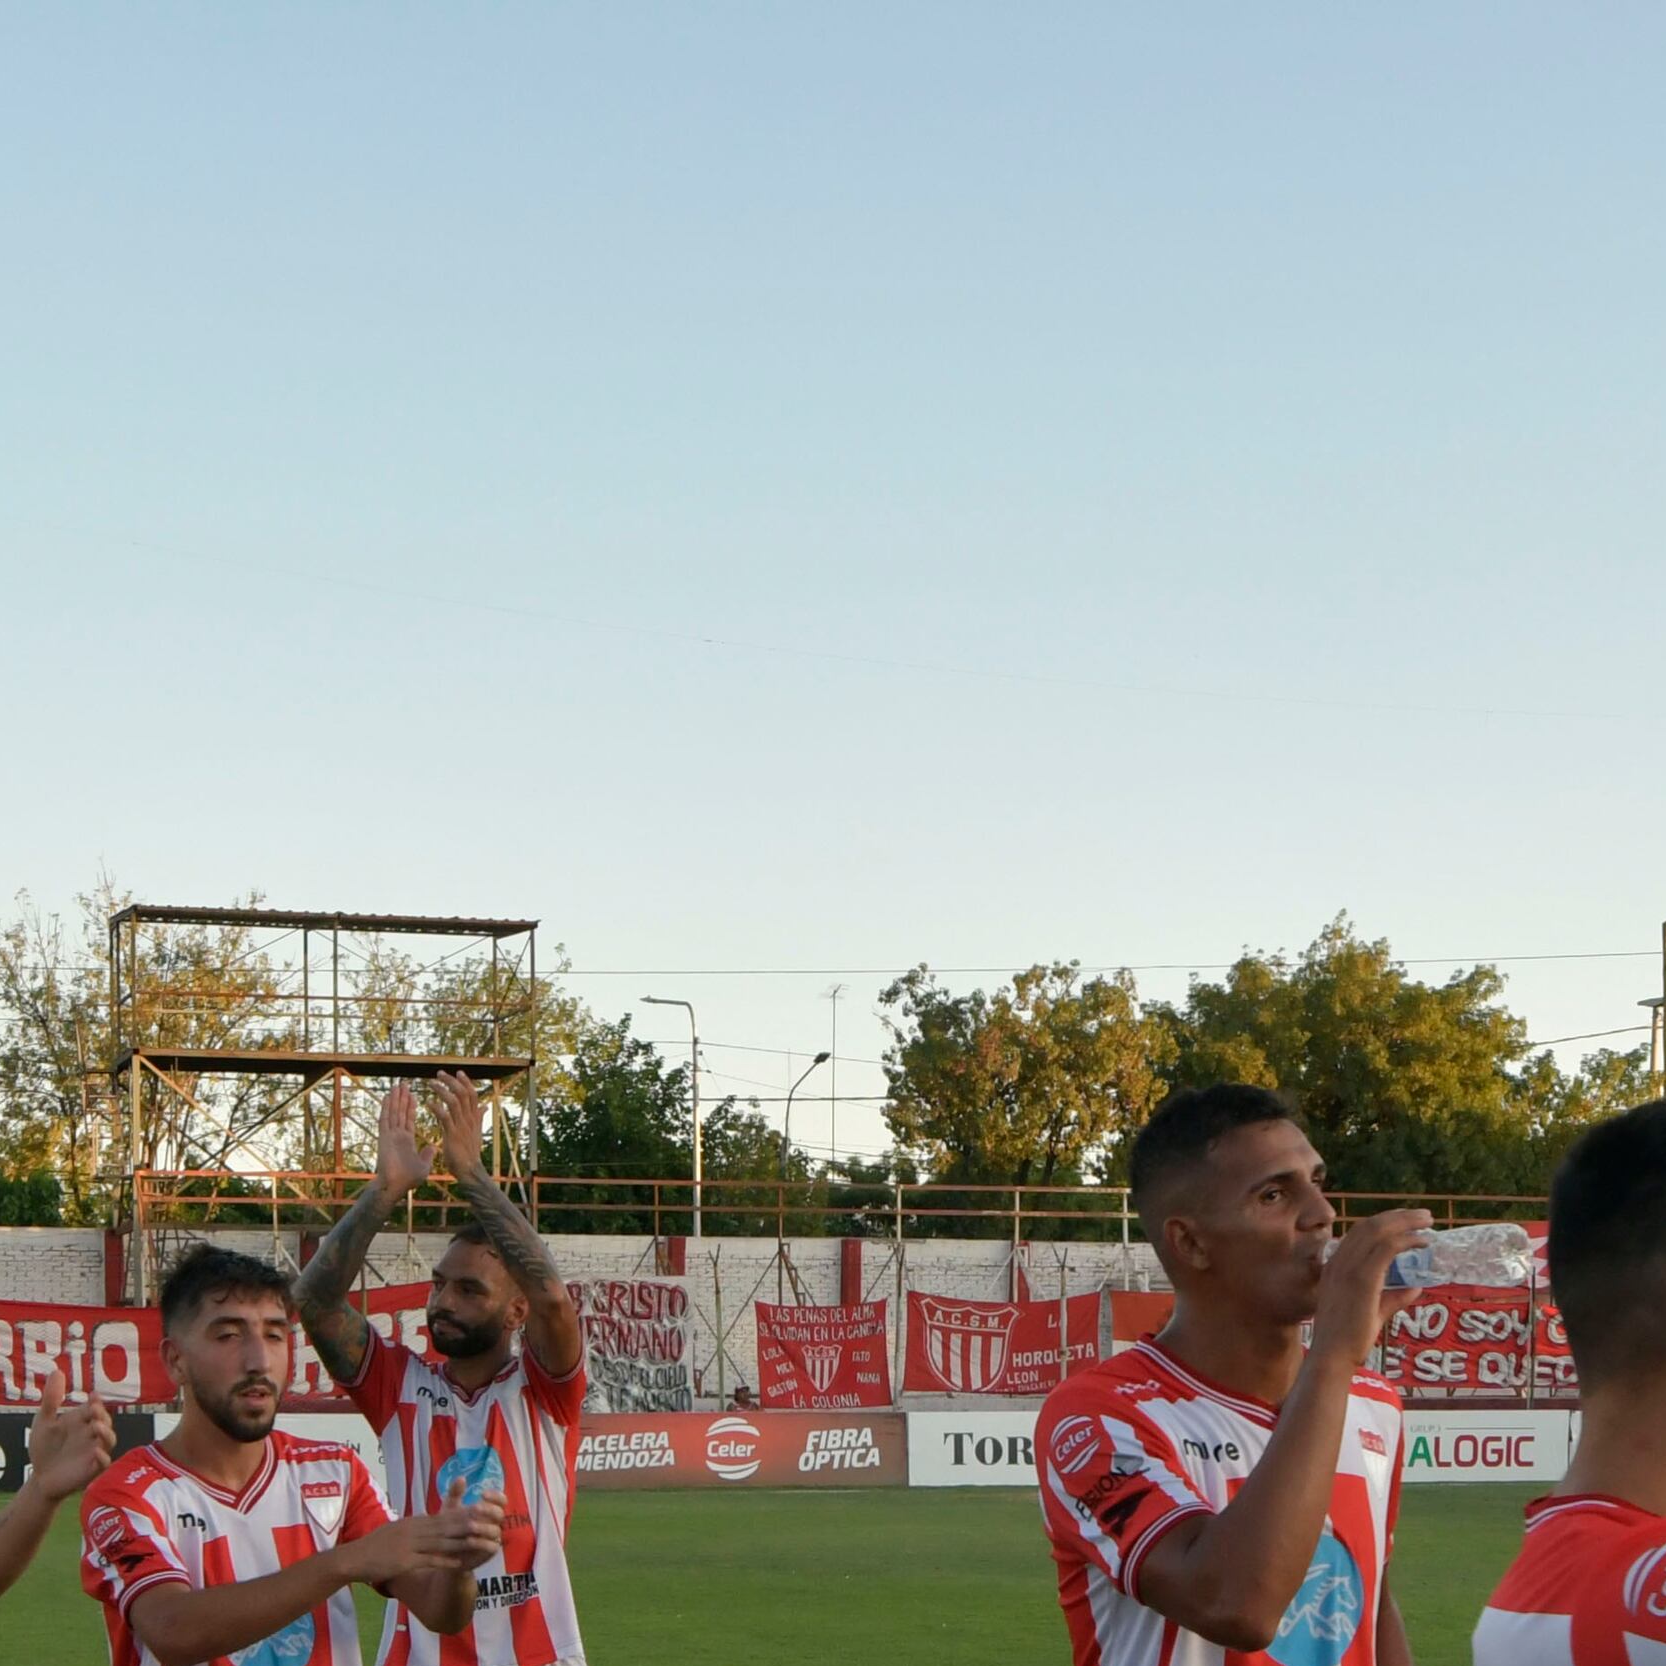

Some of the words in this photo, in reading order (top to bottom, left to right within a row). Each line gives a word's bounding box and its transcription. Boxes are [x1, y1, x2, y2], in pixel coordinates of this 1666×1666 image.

[593, 1279, 688, 1322] CRISTO
[770, 1307, 790, 1322] LAS
[830, 1308, 848, 1322] DEL
[1390, 1303, 1449, 1338] NO
[814, 1327, 828, 1341] EN
[832, 1327, 845, 1340] LA
[1413, 1350, 1468, 1381] SE
[1007, 1371, 1039, 1385] LEON
[792, 1393, 806, 1408] LA
[812, 1393, 861, 1408] COLONIA
[578, 1431, 669, 1452] ACELERA
[707, 1440, 757, 1458] Celer
[806, 1427, 873, 1452] FIBRA
[574, 1449, 675, 1472] MENDOZA
[1402, 1435, 1536, 1468] ALOGIC
